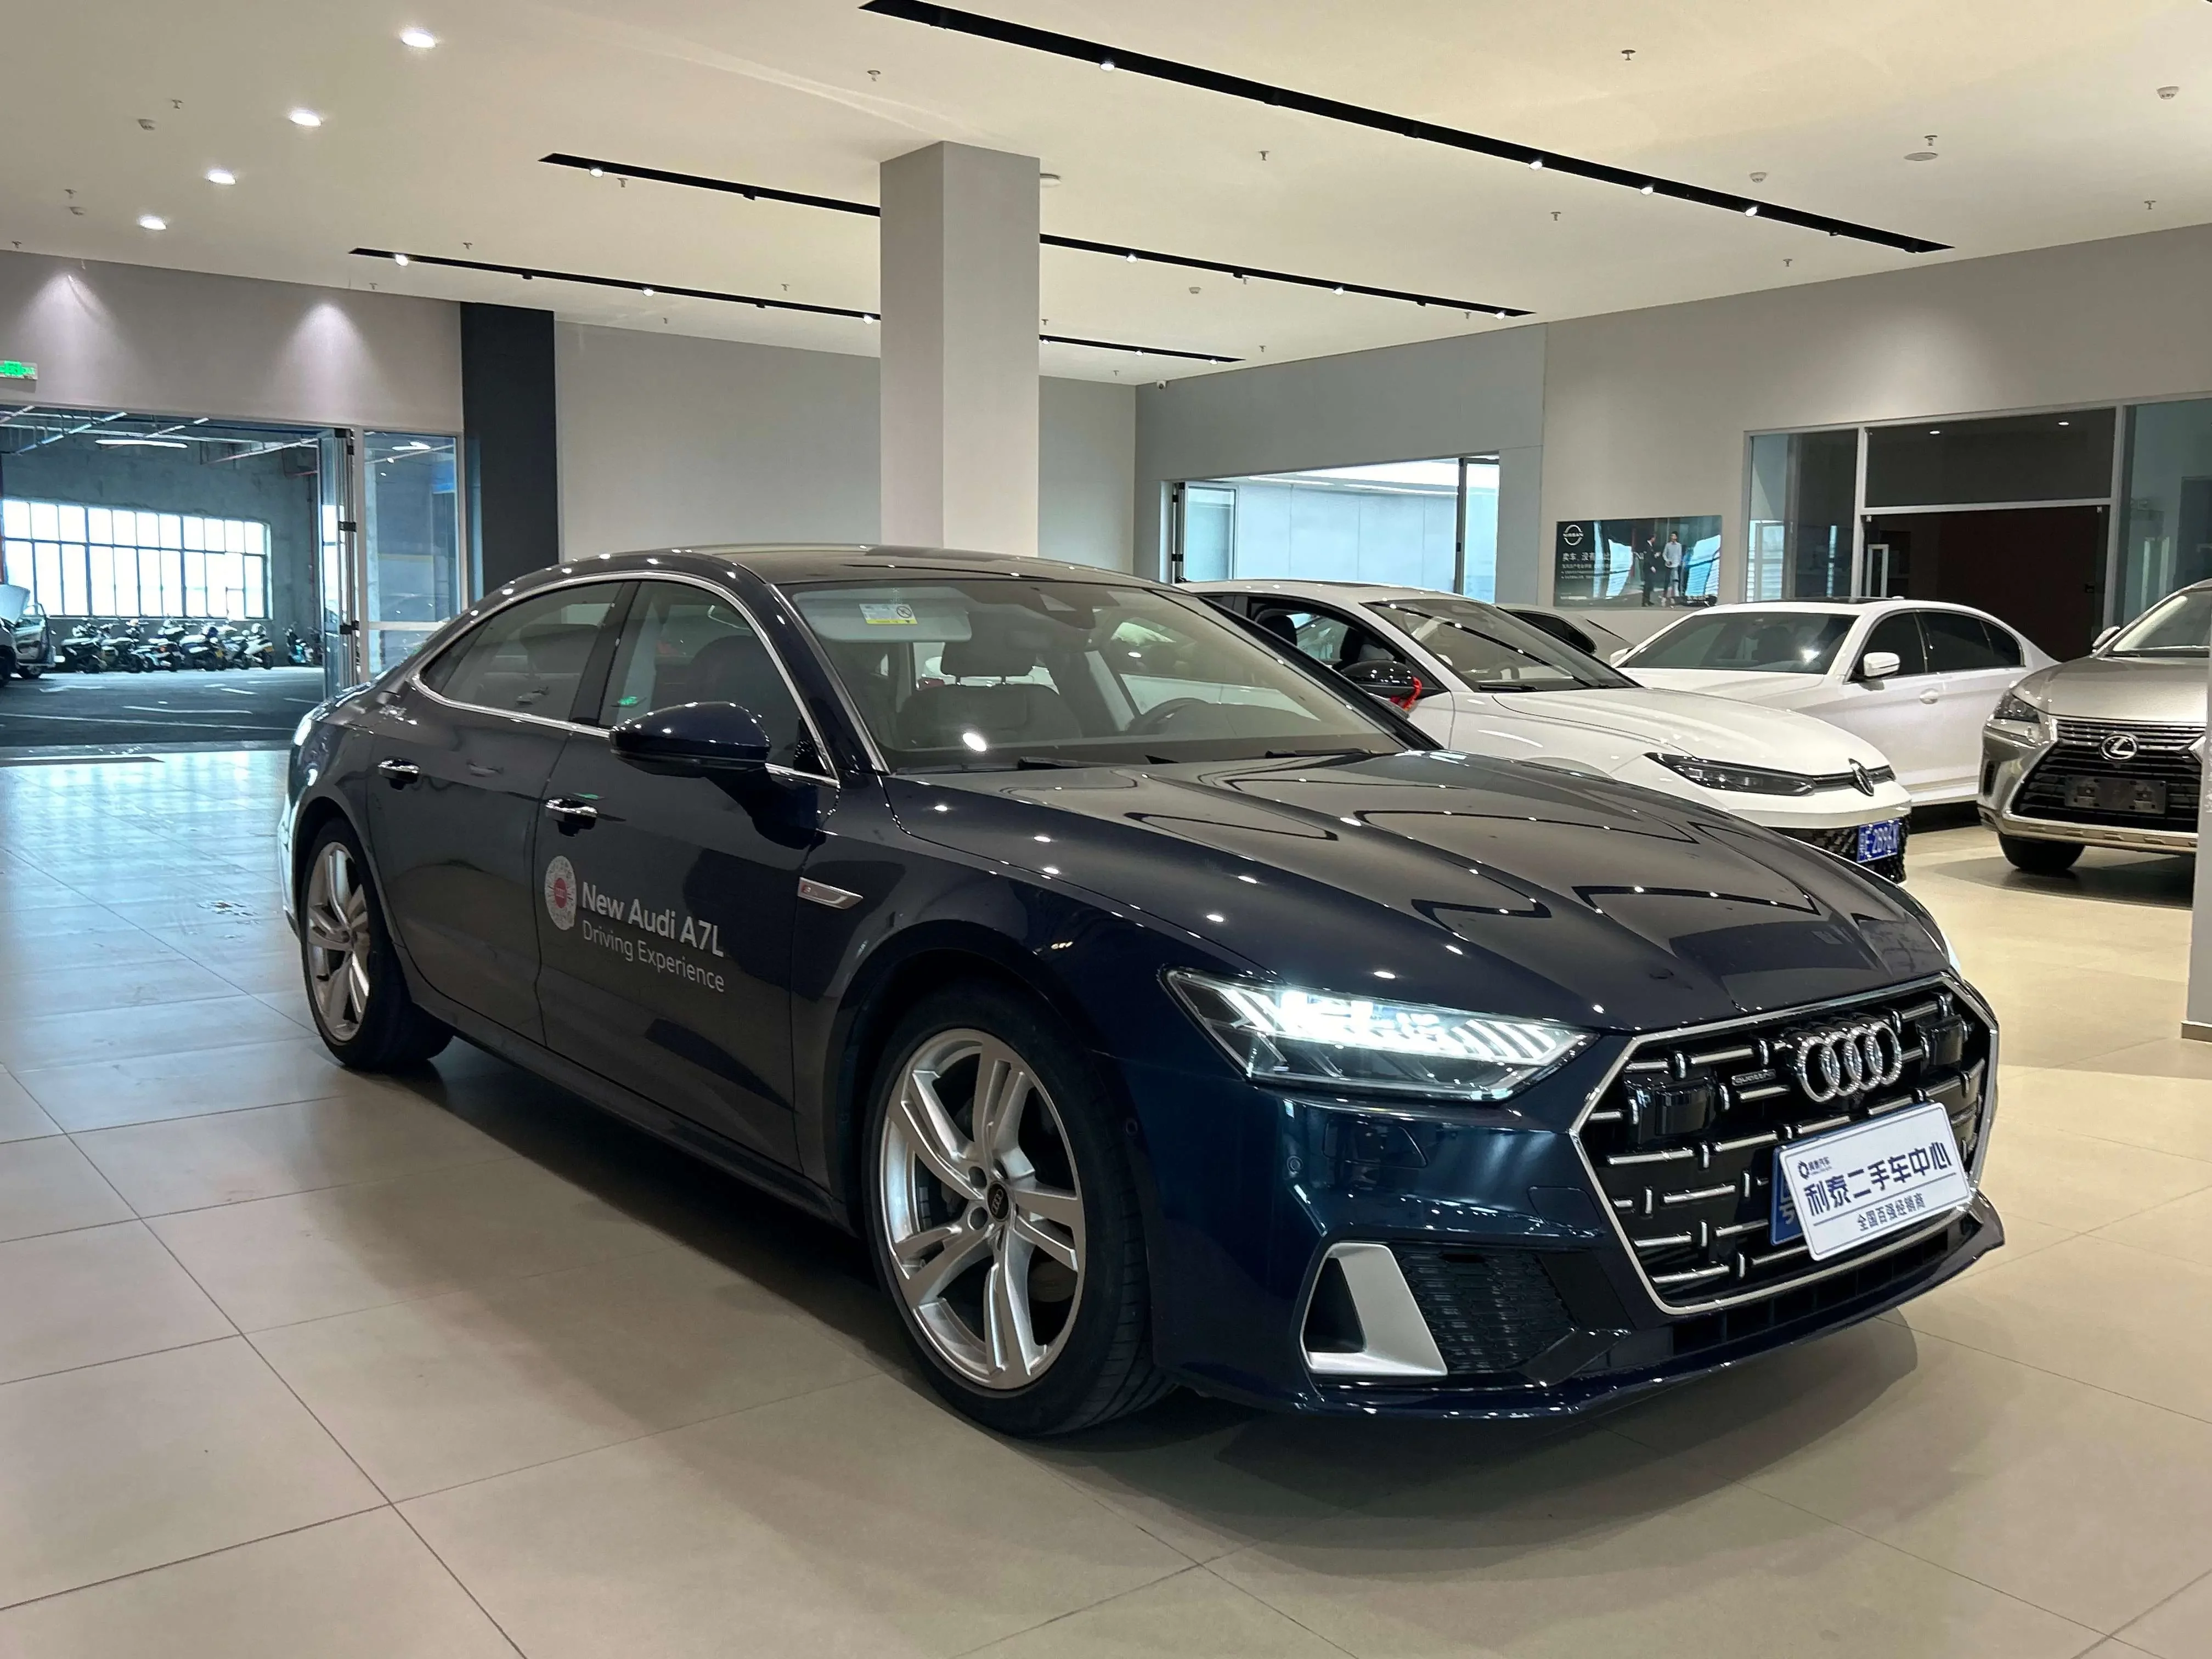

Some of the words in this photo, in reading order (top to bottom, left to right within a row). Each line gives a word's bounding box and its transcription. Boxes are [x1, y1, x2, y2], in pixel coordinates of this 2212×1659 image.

[582, 881, 625, 921] New
[628, 898, 675, 940] Audi
[679, 916, 724, 958] A7L
[583, 917, 633, 962] Driving
[637, 939, 725, 992] Experience
[1803, 1141, 1952, 1216] 利泰二手车中心
[1857, 1192, 1926, 1232] 全国百强经销商
